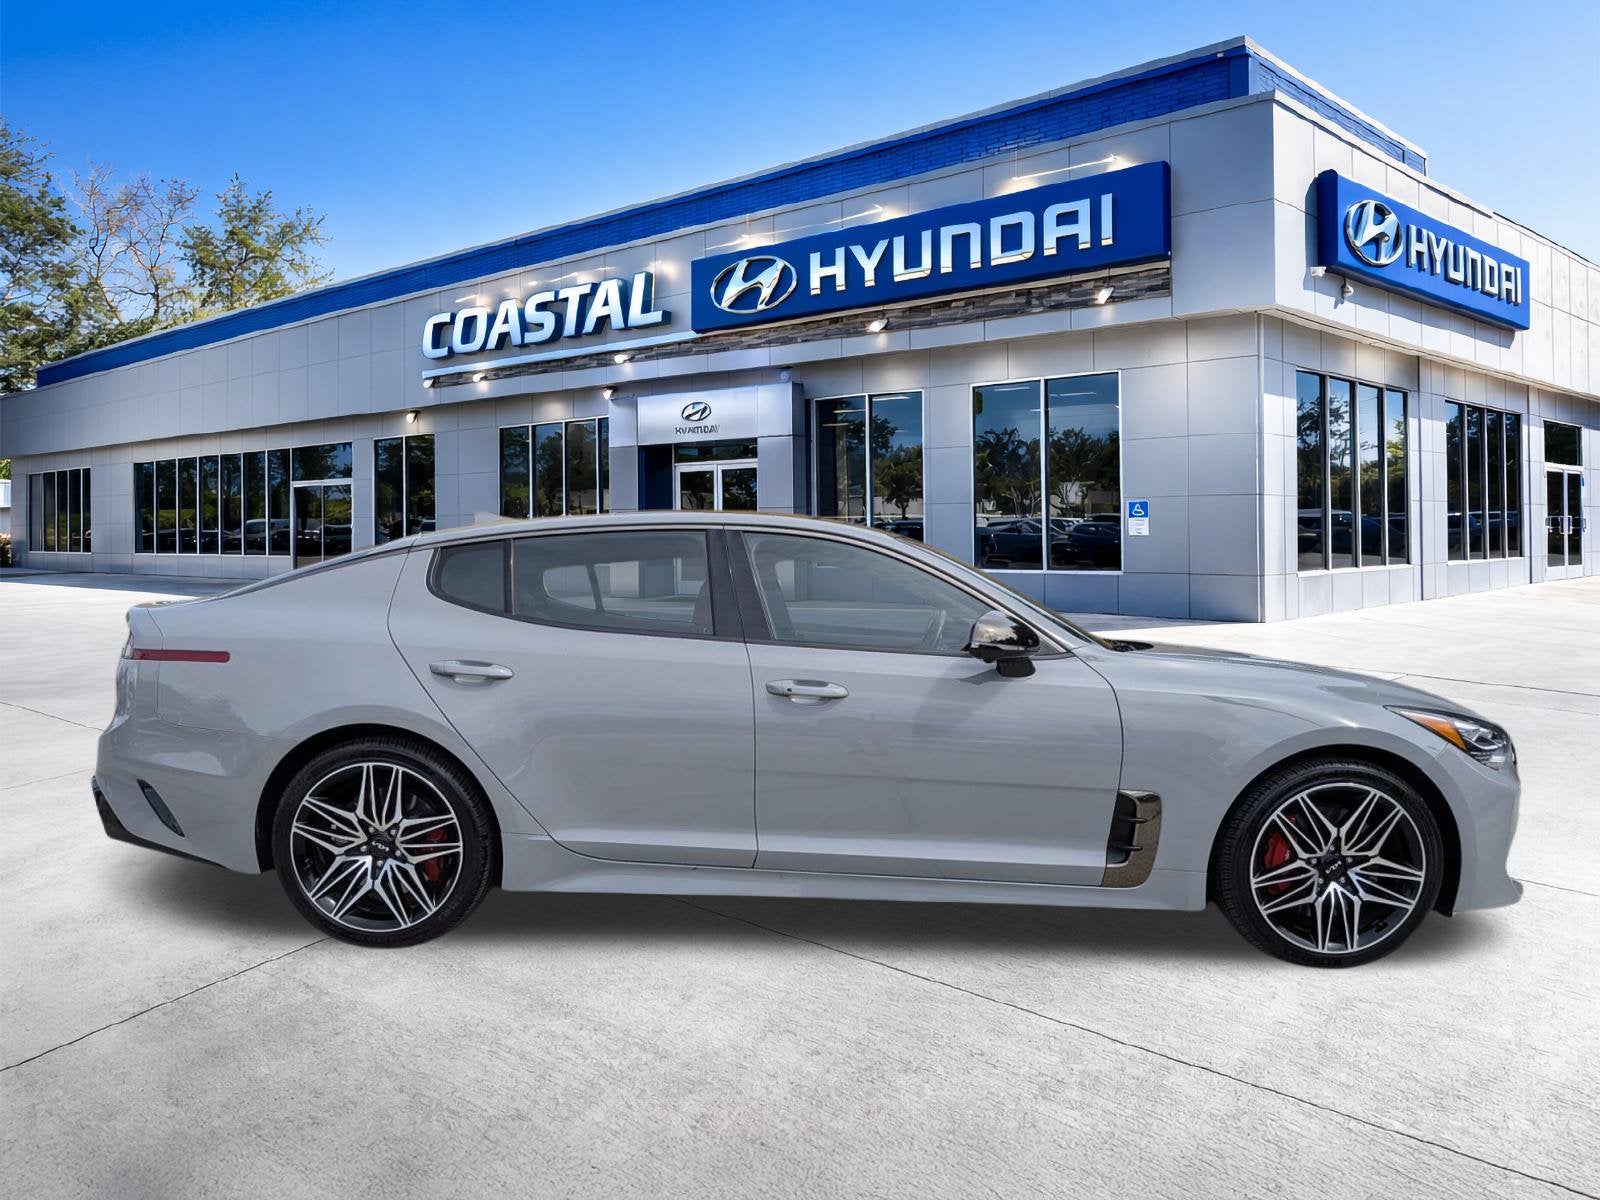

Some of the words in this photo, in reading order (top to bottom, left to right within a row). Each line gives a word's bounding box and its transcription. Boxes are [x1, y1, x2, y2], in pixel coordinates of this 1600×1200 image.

[808, 193, 1114, 295] HYUNDAI
[1407, 225, 1521, 306] HYUNDAI
[423, 272, 667, 360] COASTAL
